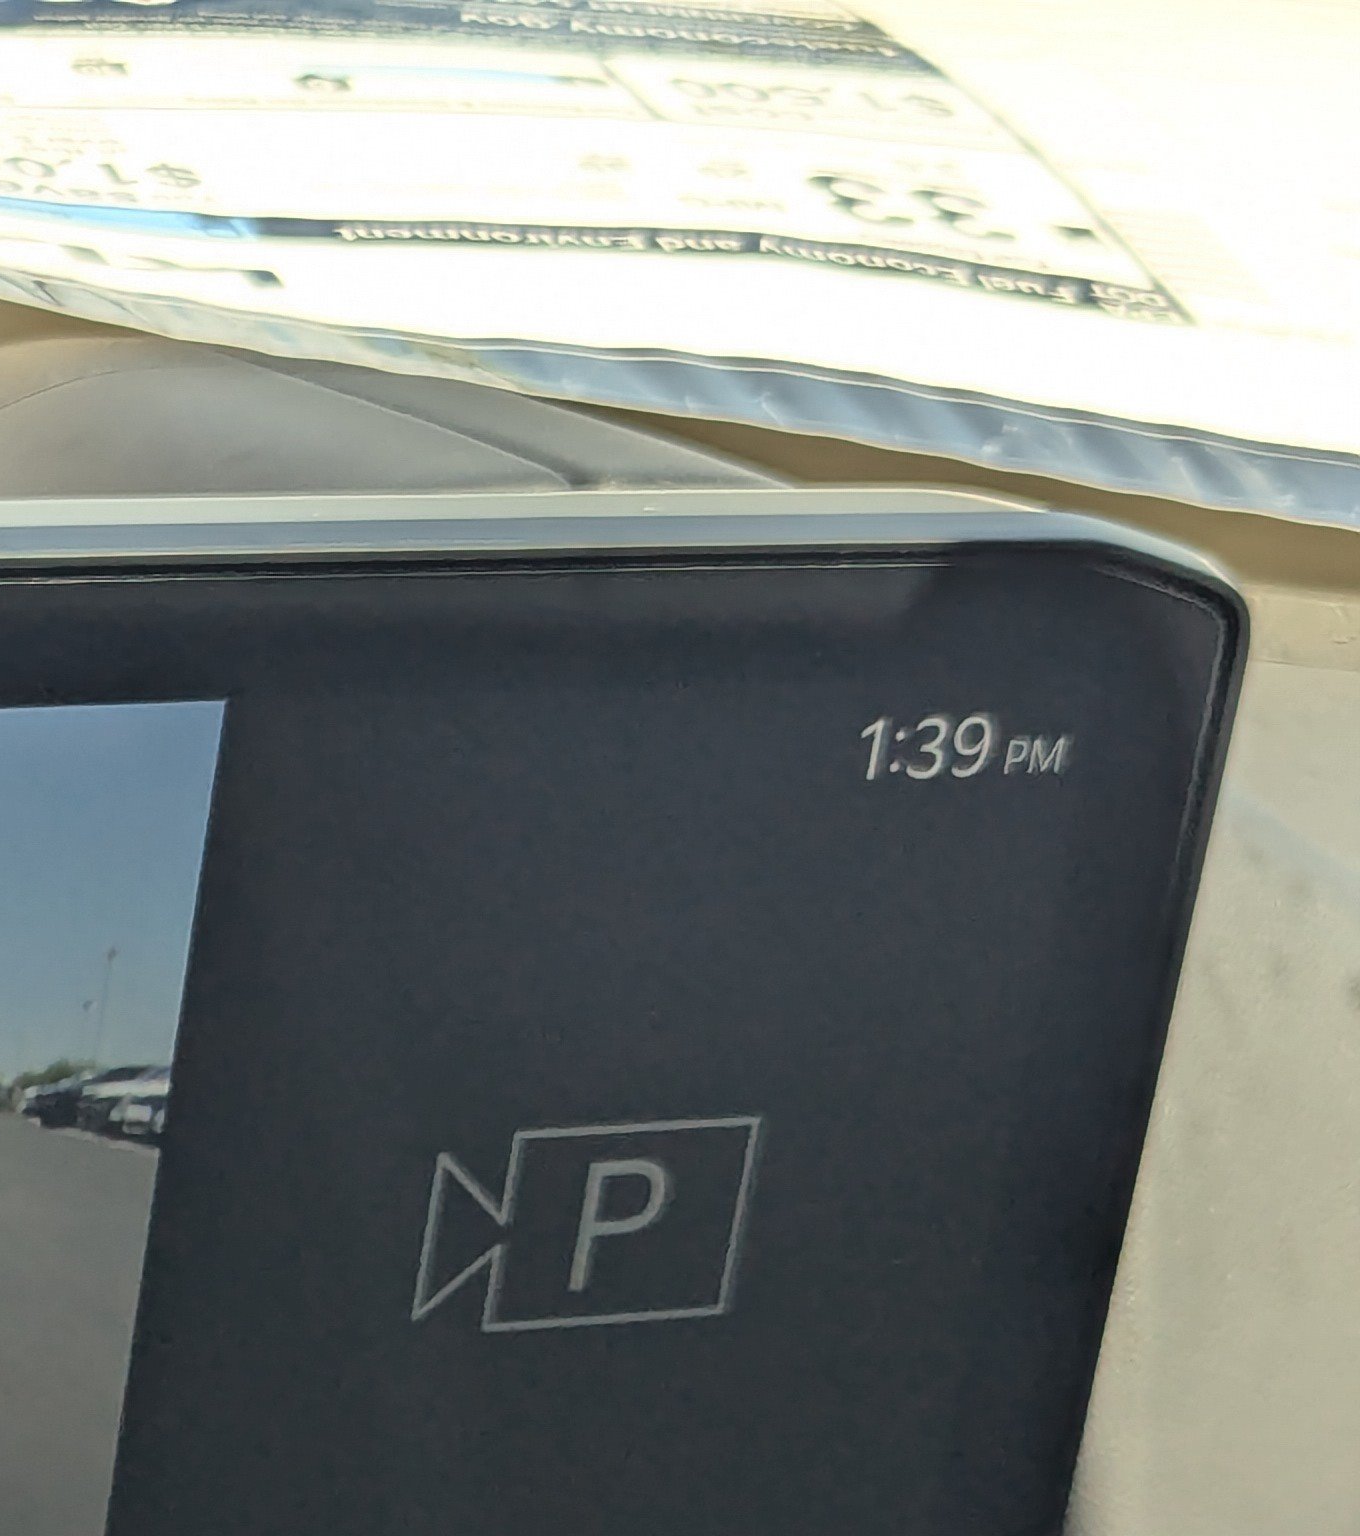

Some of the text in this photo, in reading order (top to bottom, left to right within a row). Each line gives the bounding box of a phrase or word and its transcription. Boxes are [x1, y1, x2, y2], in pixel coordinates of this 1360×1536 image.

[803, 174, 1018, 246] 33
[333, 226, 649, 252] Environment
[653, 235, 743, 253] and
[758, 234, 973, 288] Economy
[977, 274, 1079, 305] Fuel
[859, 712, 1072, 782] 1:39 PM
[567, 1158, 670, 1293] P
